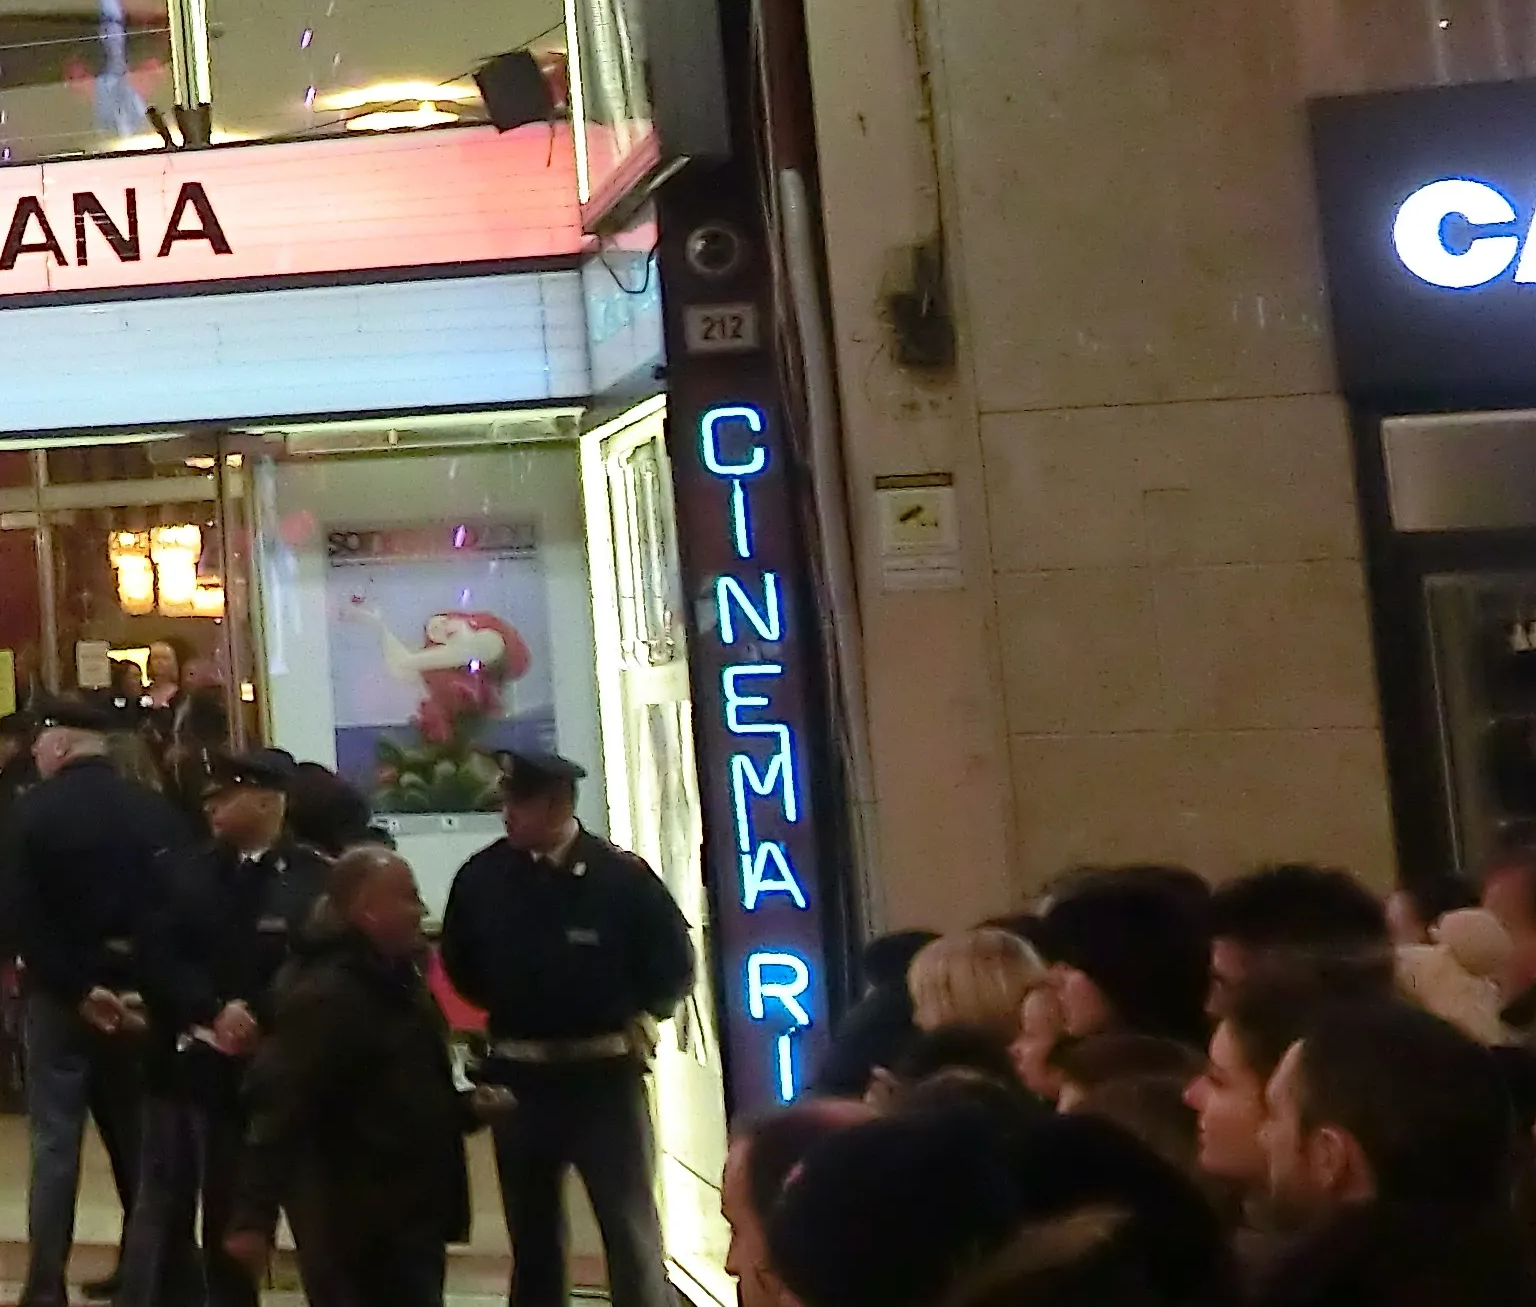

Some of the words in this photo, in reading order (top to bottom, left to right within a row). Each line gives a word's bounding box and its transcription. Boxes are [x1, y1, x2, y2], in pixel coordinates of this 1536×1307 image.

[1392, 178, 1536, 289] C
[702, 314, 745, 341] 212
[701, 406, 809, 910] CINEMA
